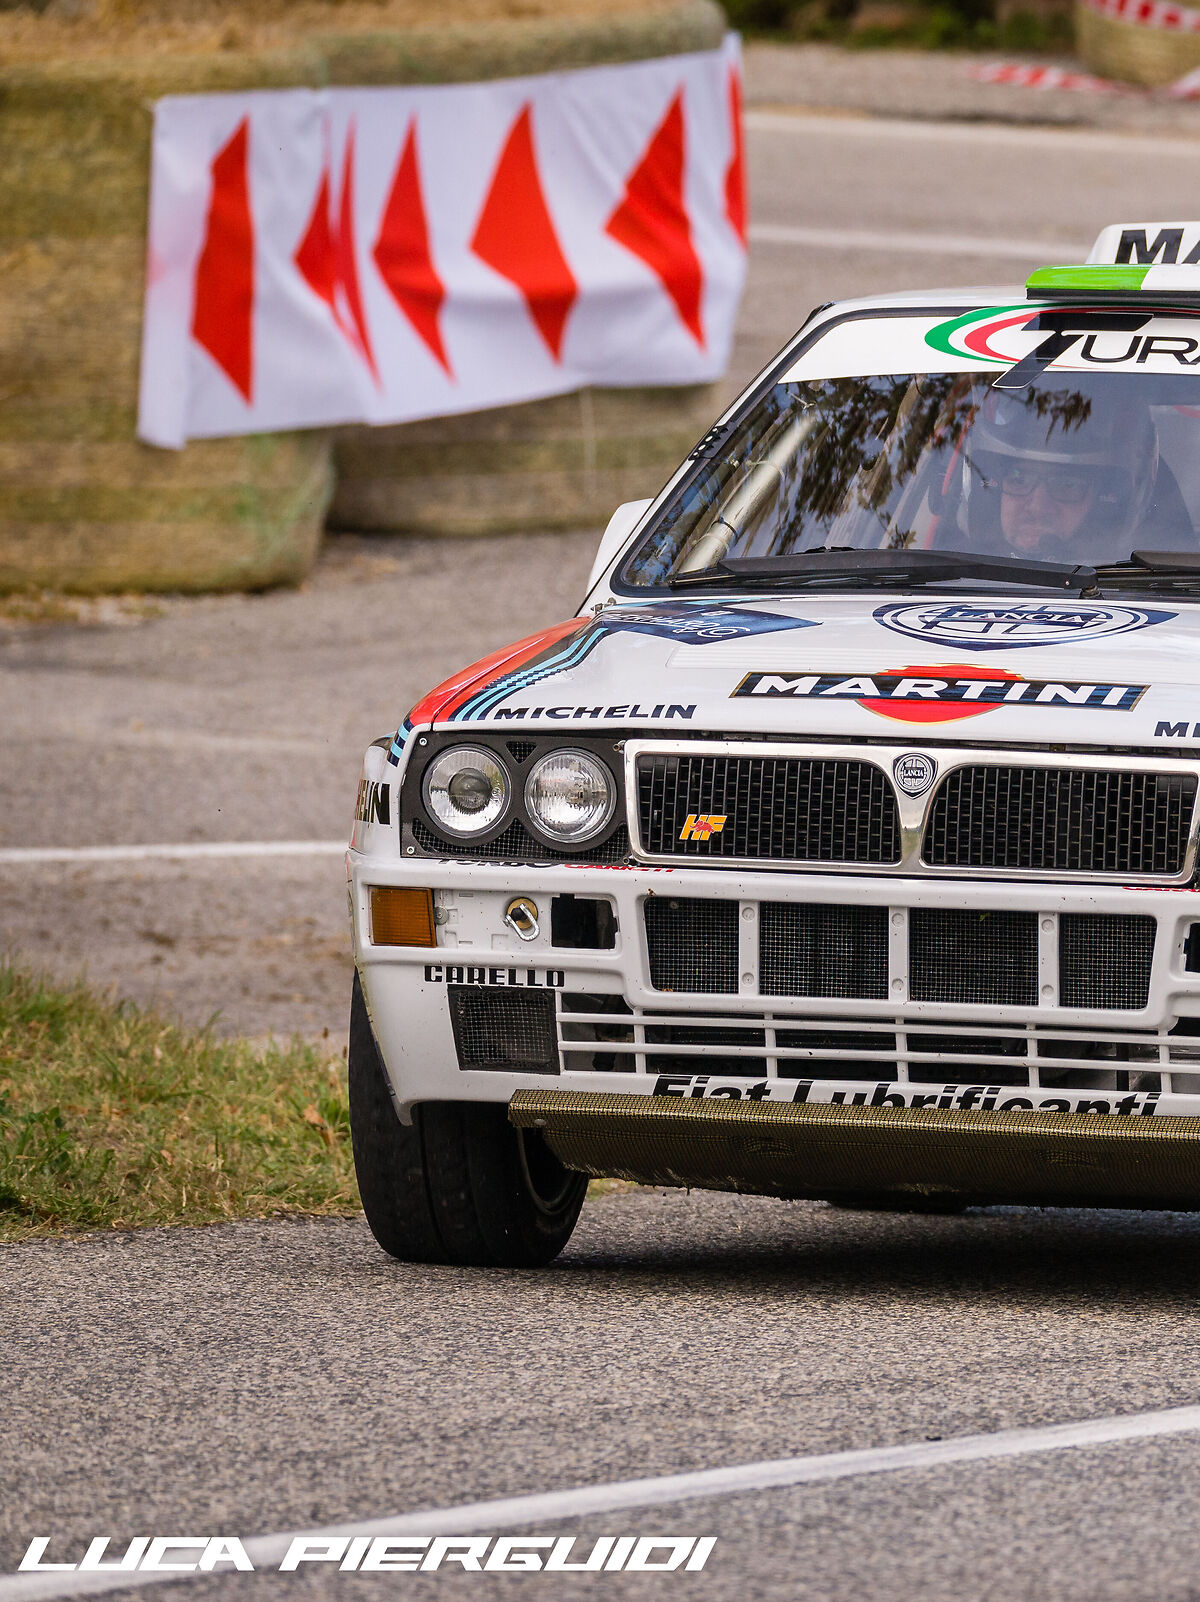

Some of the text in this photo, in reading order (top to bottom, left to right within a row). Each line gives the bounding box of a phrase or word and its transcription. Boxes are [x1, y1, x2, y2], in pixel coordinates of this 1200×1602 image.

[946, 610, 1085, 624] LANCIA
[750, 673, 1129, 706] MARTINI
[494, 703, 698, 721] MICHELIN
[903, 768, 924, 777] LANCIA
[679, 814, 728, 840] HF
[424, 965, 565, 988] CARELLO
